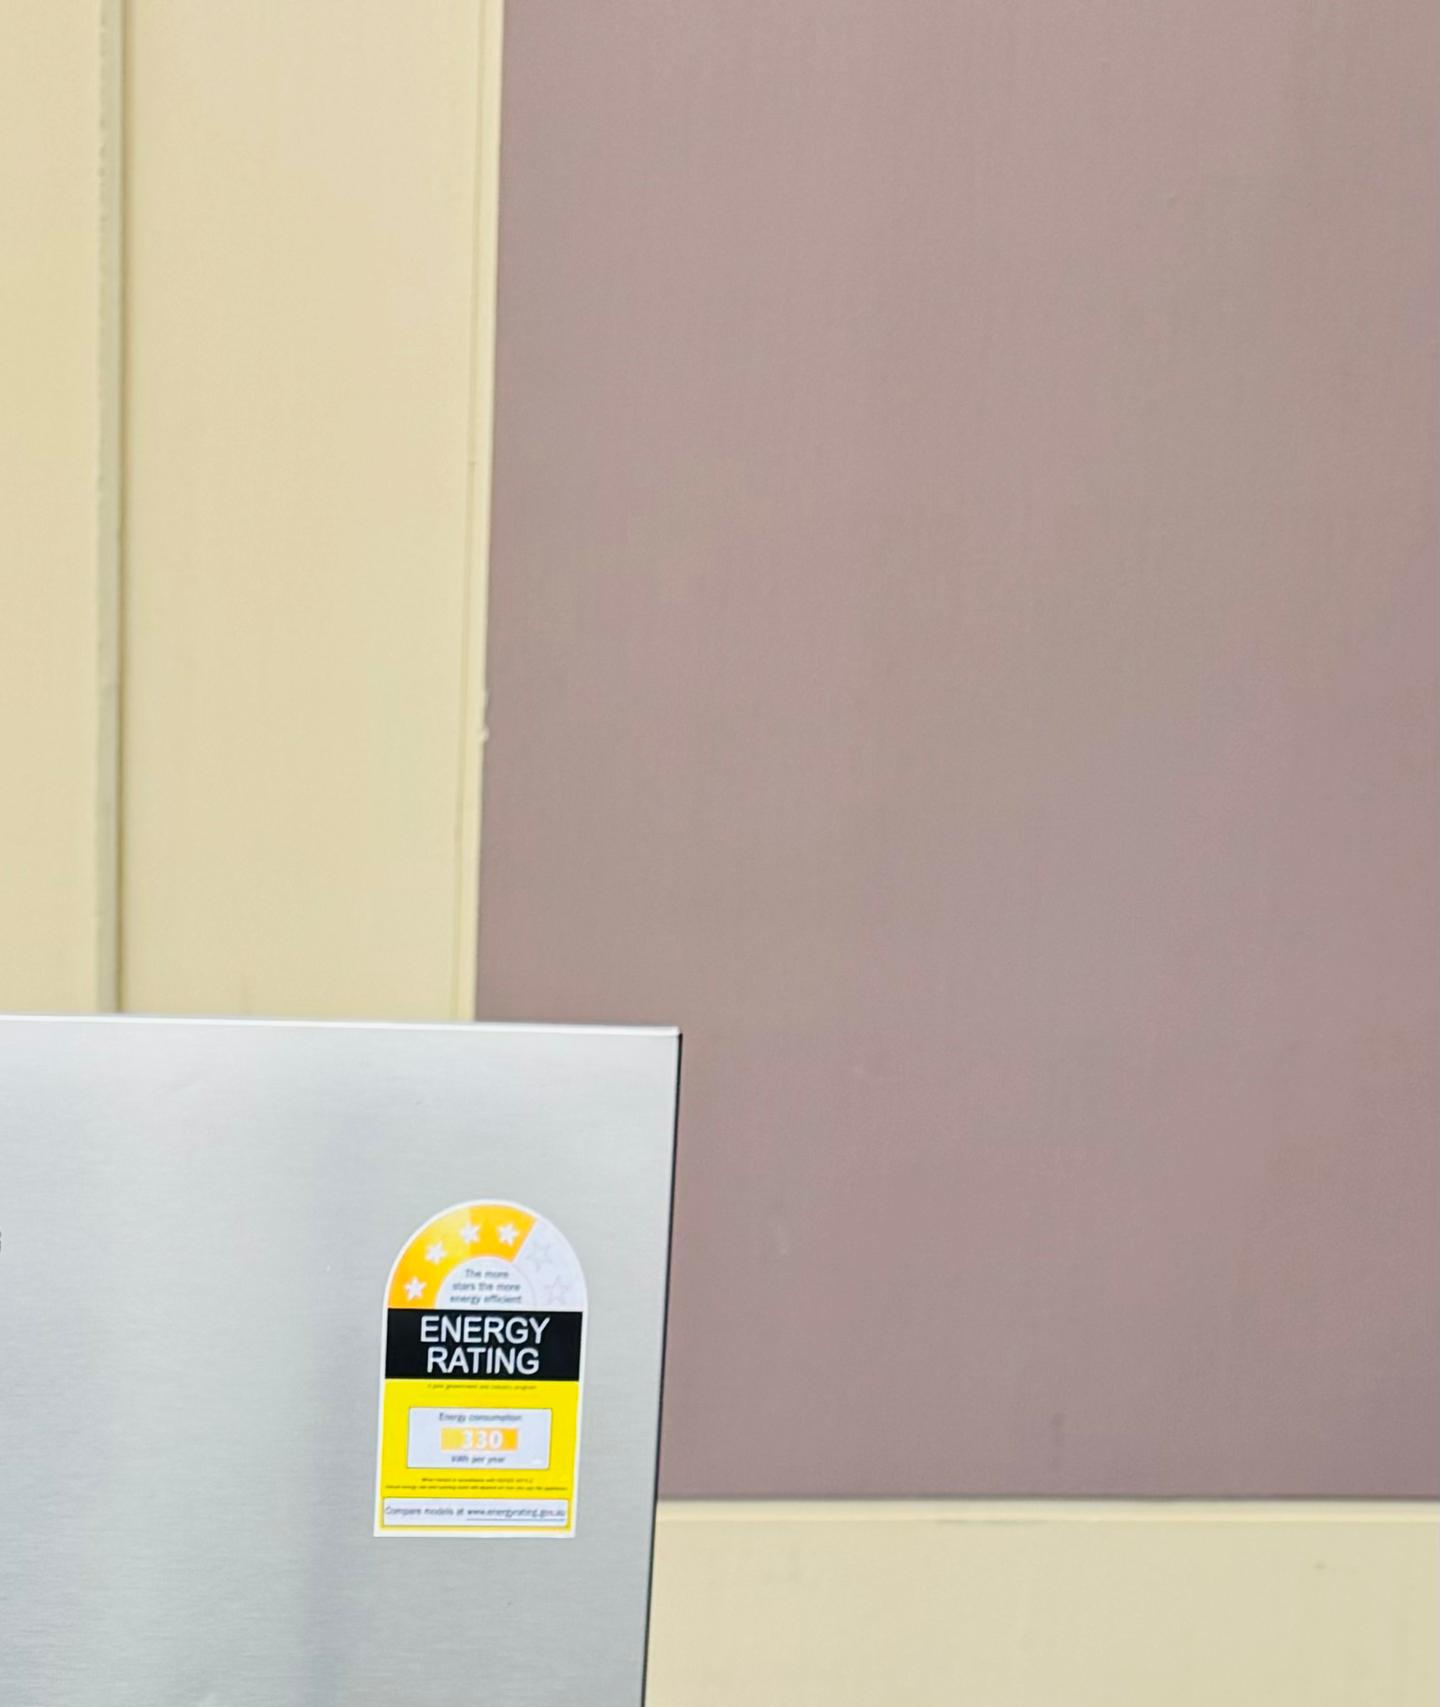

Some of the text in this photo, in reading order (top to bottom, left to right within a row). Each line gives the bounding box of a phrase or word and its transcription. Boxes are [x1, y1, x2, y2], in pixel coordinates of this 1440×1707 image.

[465, 1268, 481, 1278] The
[420, 1315, 550, 1344] ENERGY
[427, 1346, 540, 1375] RATING
[439, 1412, 466, 1422] Energy
